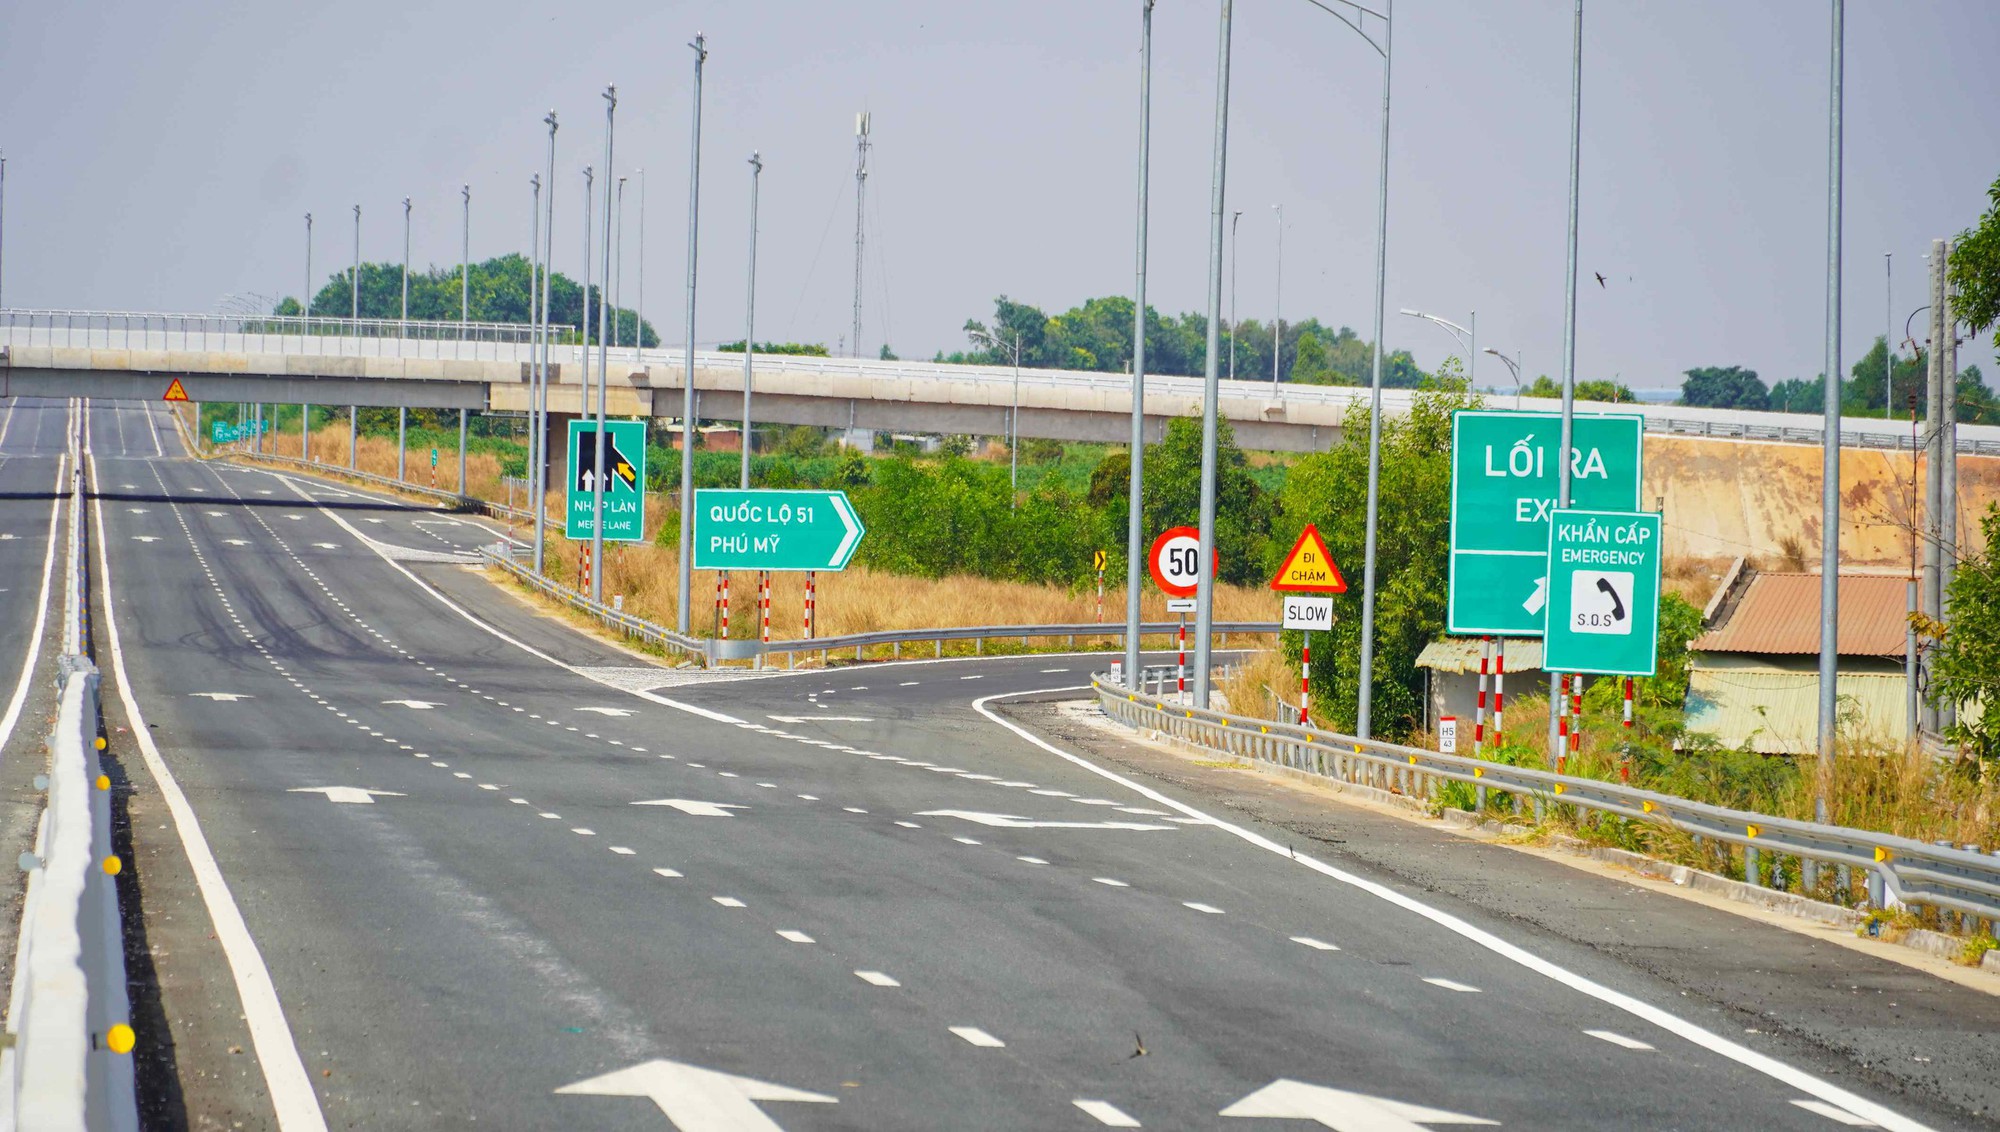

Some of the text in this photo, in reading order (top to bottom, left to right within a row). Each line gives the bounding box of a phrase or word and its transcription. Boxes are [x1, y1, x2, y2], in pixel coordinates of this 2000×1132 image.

[1485, 433, 1608, 479] LỐI RA
[611, 498, 636, 513] LÀN
[710, 500, 813, 526] QUỐC LỘ 51
[1516, 498, 1576, 522] EX
[608, 520, 631, 530] LANE
[1558, 517, 1651, 545] KHẢN CẤP
[710, 533, 780, 553] PHÚ MỸ
[1169, 548, 1198, 576] 50
[1303, 552, 1315, 563] ĐI
[1561, 548, 1645, 565] EMERGENCY
[1291, 568, 1326, 583] CHẬM
[1288, 605, 1328, 622] SLOW
[1577, 613, 1612, 627] S.O.S
[1442, 727, 1454, 736] H5
[1443, 740, 1452, 748] 43
